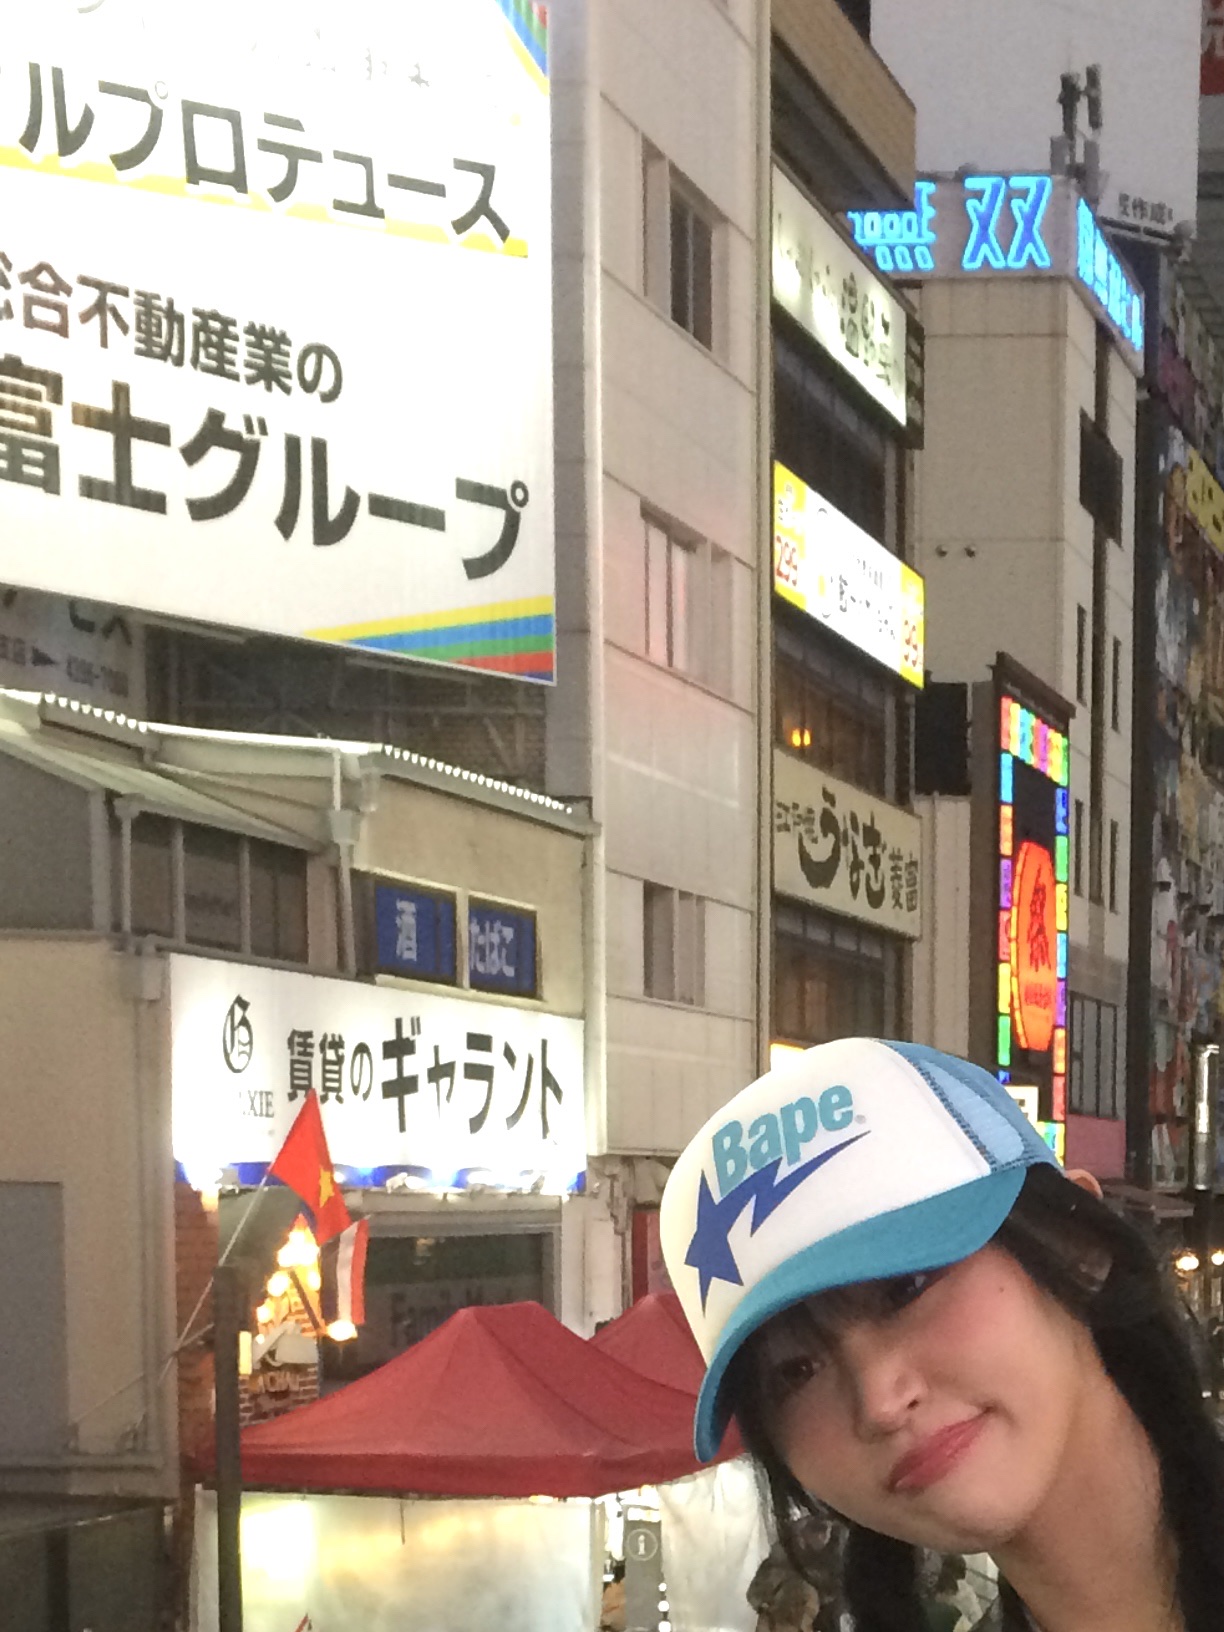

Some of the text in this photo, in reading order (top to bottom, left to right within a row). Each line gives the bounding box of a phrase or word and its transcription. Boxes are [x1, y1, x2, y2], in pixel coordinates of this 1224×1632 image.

[0, 251, 344, 404] 合不動産業の
[0, 353, 530, 581] 富士グループ
[469, 916, 516, 978] たばこ
[286, 1015, 564, 1140] 賃貸のギャラント
[711, 1084, 854, 1199] Bape
